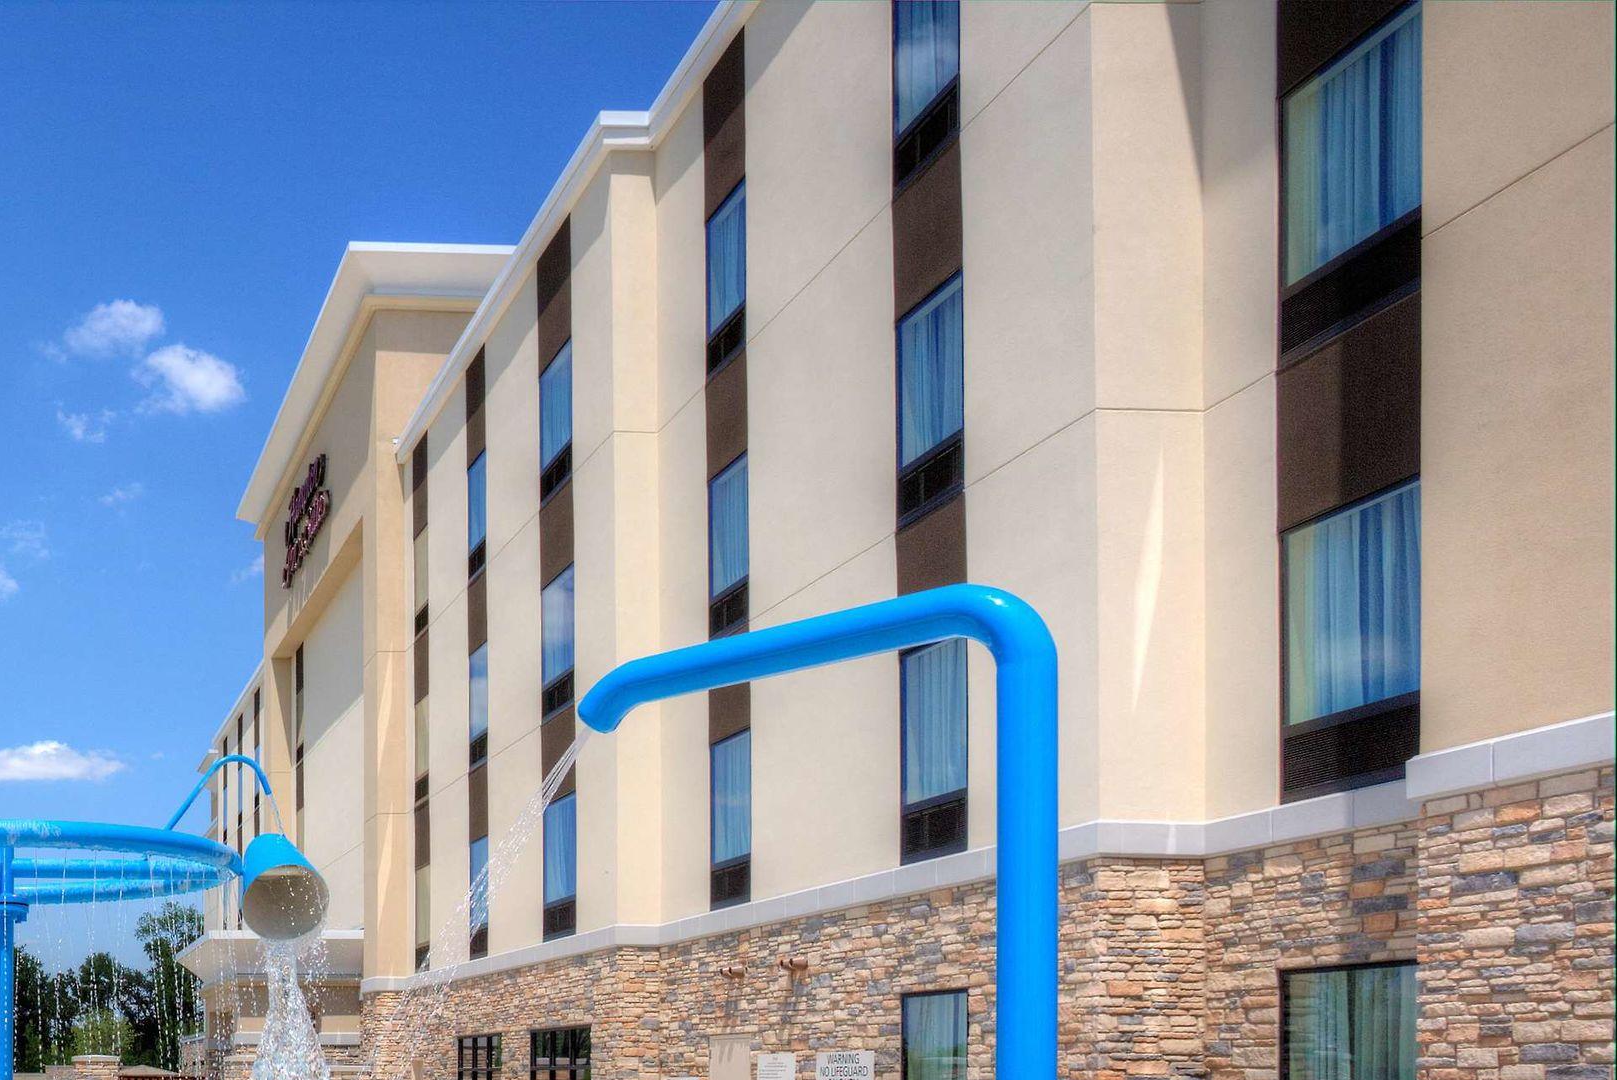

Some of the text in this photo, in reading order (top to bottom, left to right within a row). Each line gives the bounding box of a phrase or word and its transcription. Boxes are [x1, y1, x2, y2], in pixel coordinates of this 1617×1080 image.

[827, 1053, 860, 1065] WARNING
[820, 1065, 869, 1077] NO LIFEGUARD
